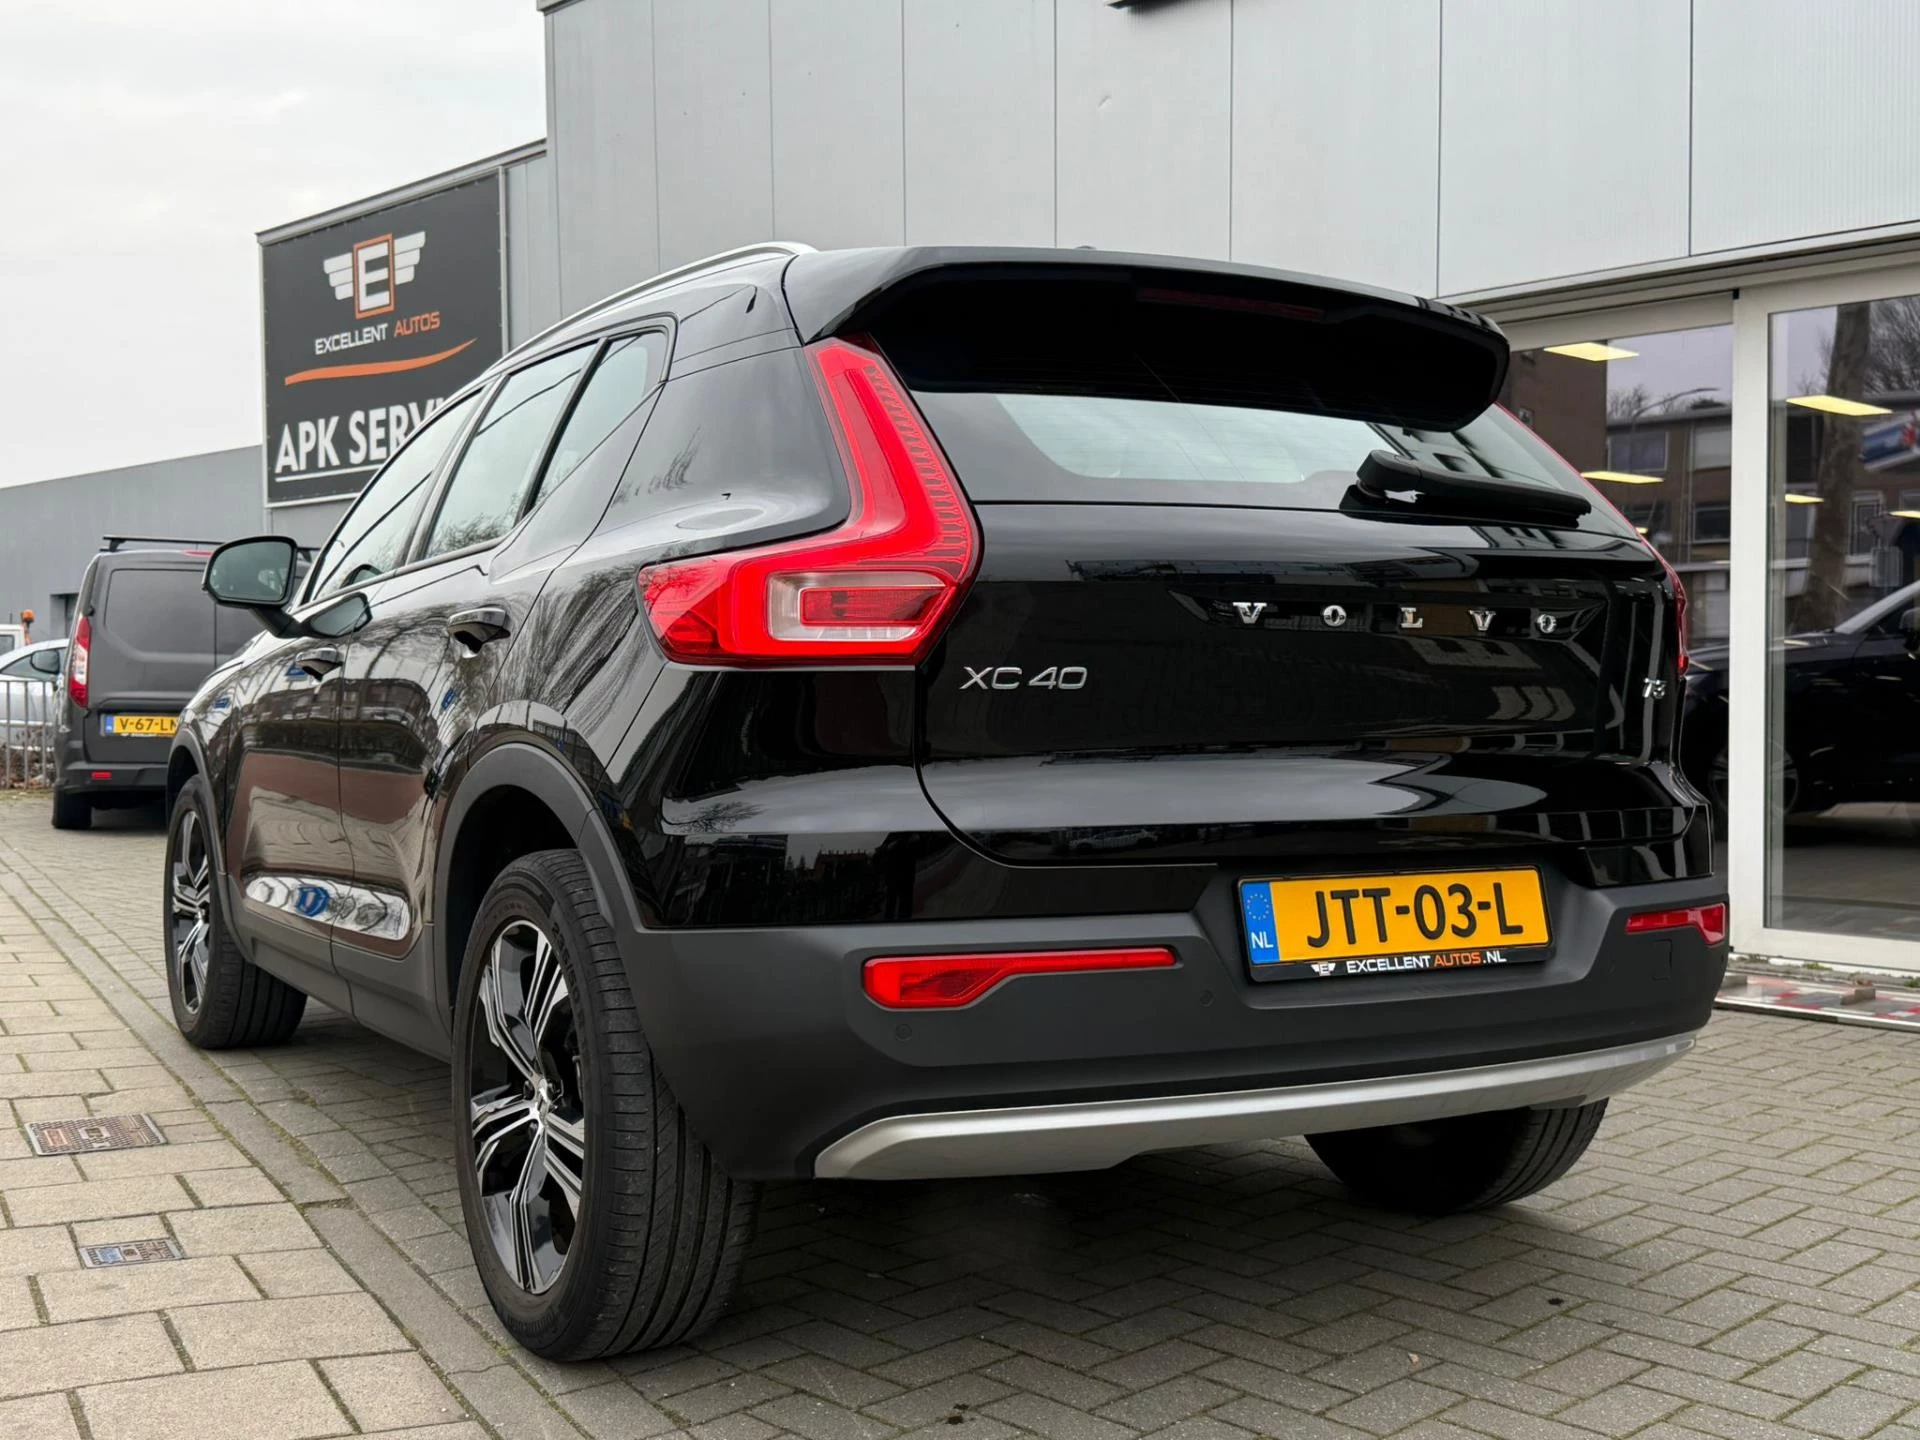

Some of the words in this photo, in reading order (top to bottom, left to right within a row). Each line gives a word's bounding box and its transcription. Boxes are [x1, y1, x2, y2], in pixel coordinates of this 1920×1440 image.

[357, 241, 390, 311] E
[315, 323, 388, 355] EXCELLENT
[394, 311, 440, 337] AUTOS
[275, 416, 340, 473] APK
[1233, 601, 1557, 634] VOLVO
[1251, 931, 1274, 949] NL
[1307, 882, 1524, 948] JTT-03-L
